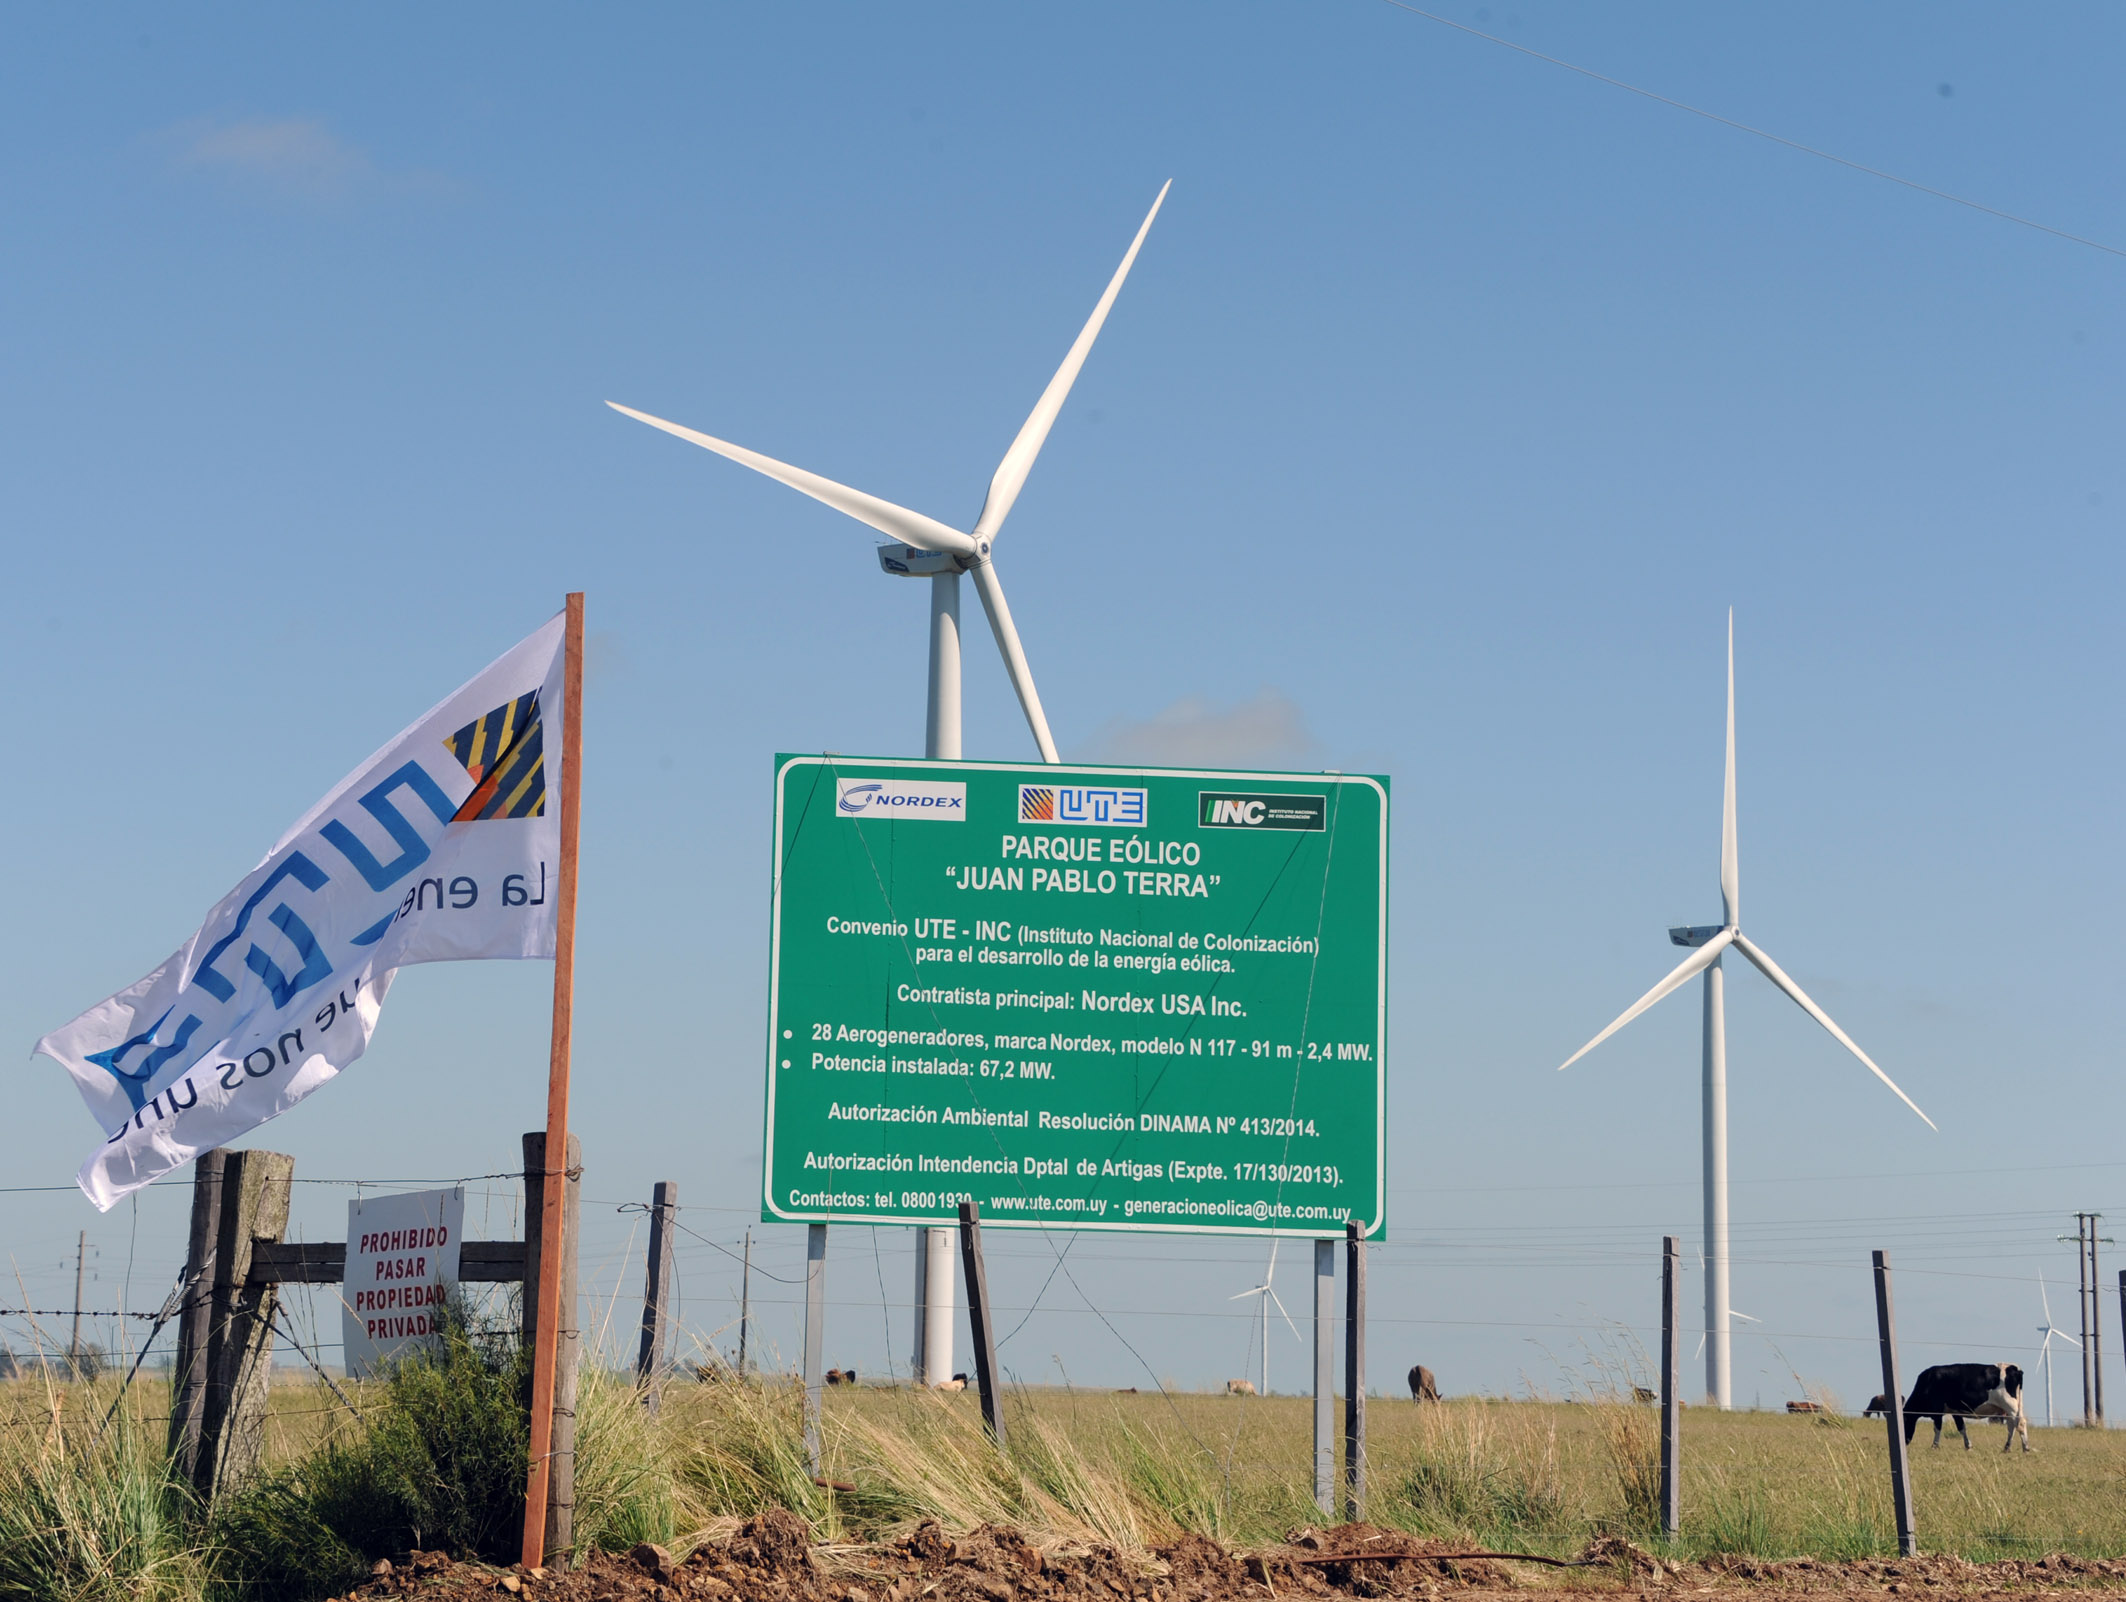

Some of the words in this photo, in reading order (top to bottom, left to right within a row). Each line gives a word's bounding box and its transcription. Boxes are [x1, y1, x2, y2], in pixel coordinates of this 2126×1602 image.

[876, 794, 962, 809] NORDEX
[1059, 789, 1144, 823] UTE
[1211, 799, 1267, 825] INC
[1003, 836, 1101, 861] PARQUE
[1110, 835, 1200, 865] EÓLICO
[1033, 869, 1116, 893] PABLO
[827, 917, 908, 936] Convenio
[915, 918, 955, 939] UTE
[976, 921, 1011, 941] INC
[1019, 926, 1093, 946] (Instituto
[1101, 929, 1172, 947] Nacional
[1179, 933, 1198, 949] de
[1204, 934, 1319, 958] Colonización)
[916, 948, 952, 964] para
[959, 946, 972, 962] el
[978, 947, 1063, 965] desarrollo
[1069, 950, 1089, 966] de
[1095, 951, 1108, 967] la
[1114, 953, 1176, 974] energía
[1181, 954, 1234, 972] eólica.
[898, 984, 990, 1005] Contratista
[996, 990, 1074, 1012] principal:
[1082, 990, 1154, 1013] Nordex
[1162, 994, 1205, 1015] USA
[1212, 996, 1246, 1016] Inc.
[812, 1024, 831, 1040] 28
[836, 1024, 988, 1050] Aerogeneradores,
[995, 1036, 1046, 1049] marca
[1051, 1034, 1115, 1055] Nordex,
[1122, 1037, 1184, 1054] modelo
[1190, 1039, 1201, 1055] N
[1208, 1039, 1235, 1056] 117
[1252, 1041, 1269, 1057] 91
[1277, 1045, 1291, 1057] m
[1308, 1043, 1332, 1062] 2,4
[1338, 1044, 1372, 1060] MW.
[813, 1053, 885, 1072] Potencia
[892, 1056, 973, 1075] instalada:
[980, 1060, 1014, 1080] 67,2
[1020, 1062, 1054, 1079] MW.
[828, 1103, 937, 1123] Autorización
[942, 1107, 1028, 1127] Ambiental
[1039, 1112, 1134, 1130] Resolución
[1141, 1115, 1211, 1133] DINAMA
[1241, 1118, 1319, 1136] 413/2014.
[804, 1152, 912, 1171] Autorización
[919, 1155, 1017, 1173] Intendencia
[1024, 1157, 1067, 1178] Dptal
[1077, 1159, 1097, 1175] de
[1102, 1159, 1163, 1181] Artigas
[1169, 1161, 1227, 1182] (Expte.
[1234, 1163, 1342, 1187] 17/130/2013).
[790, 1190, 869, 1207] Contactos:
[875, 1192, 896, 1207] tel.
[902, 1192, 935, 1208] 0800
[991, 1195, 1107, 1215] www.ute.com.uy
[1124, 1198, 1351, 1224] generacioneolica@ute.com.uy
[360, 1226, 448, 1254] PROHIBIDO
[376, 1257, 426, 1281] PASAR
[356, 1284, 447, 1312] PROPIEDAD
